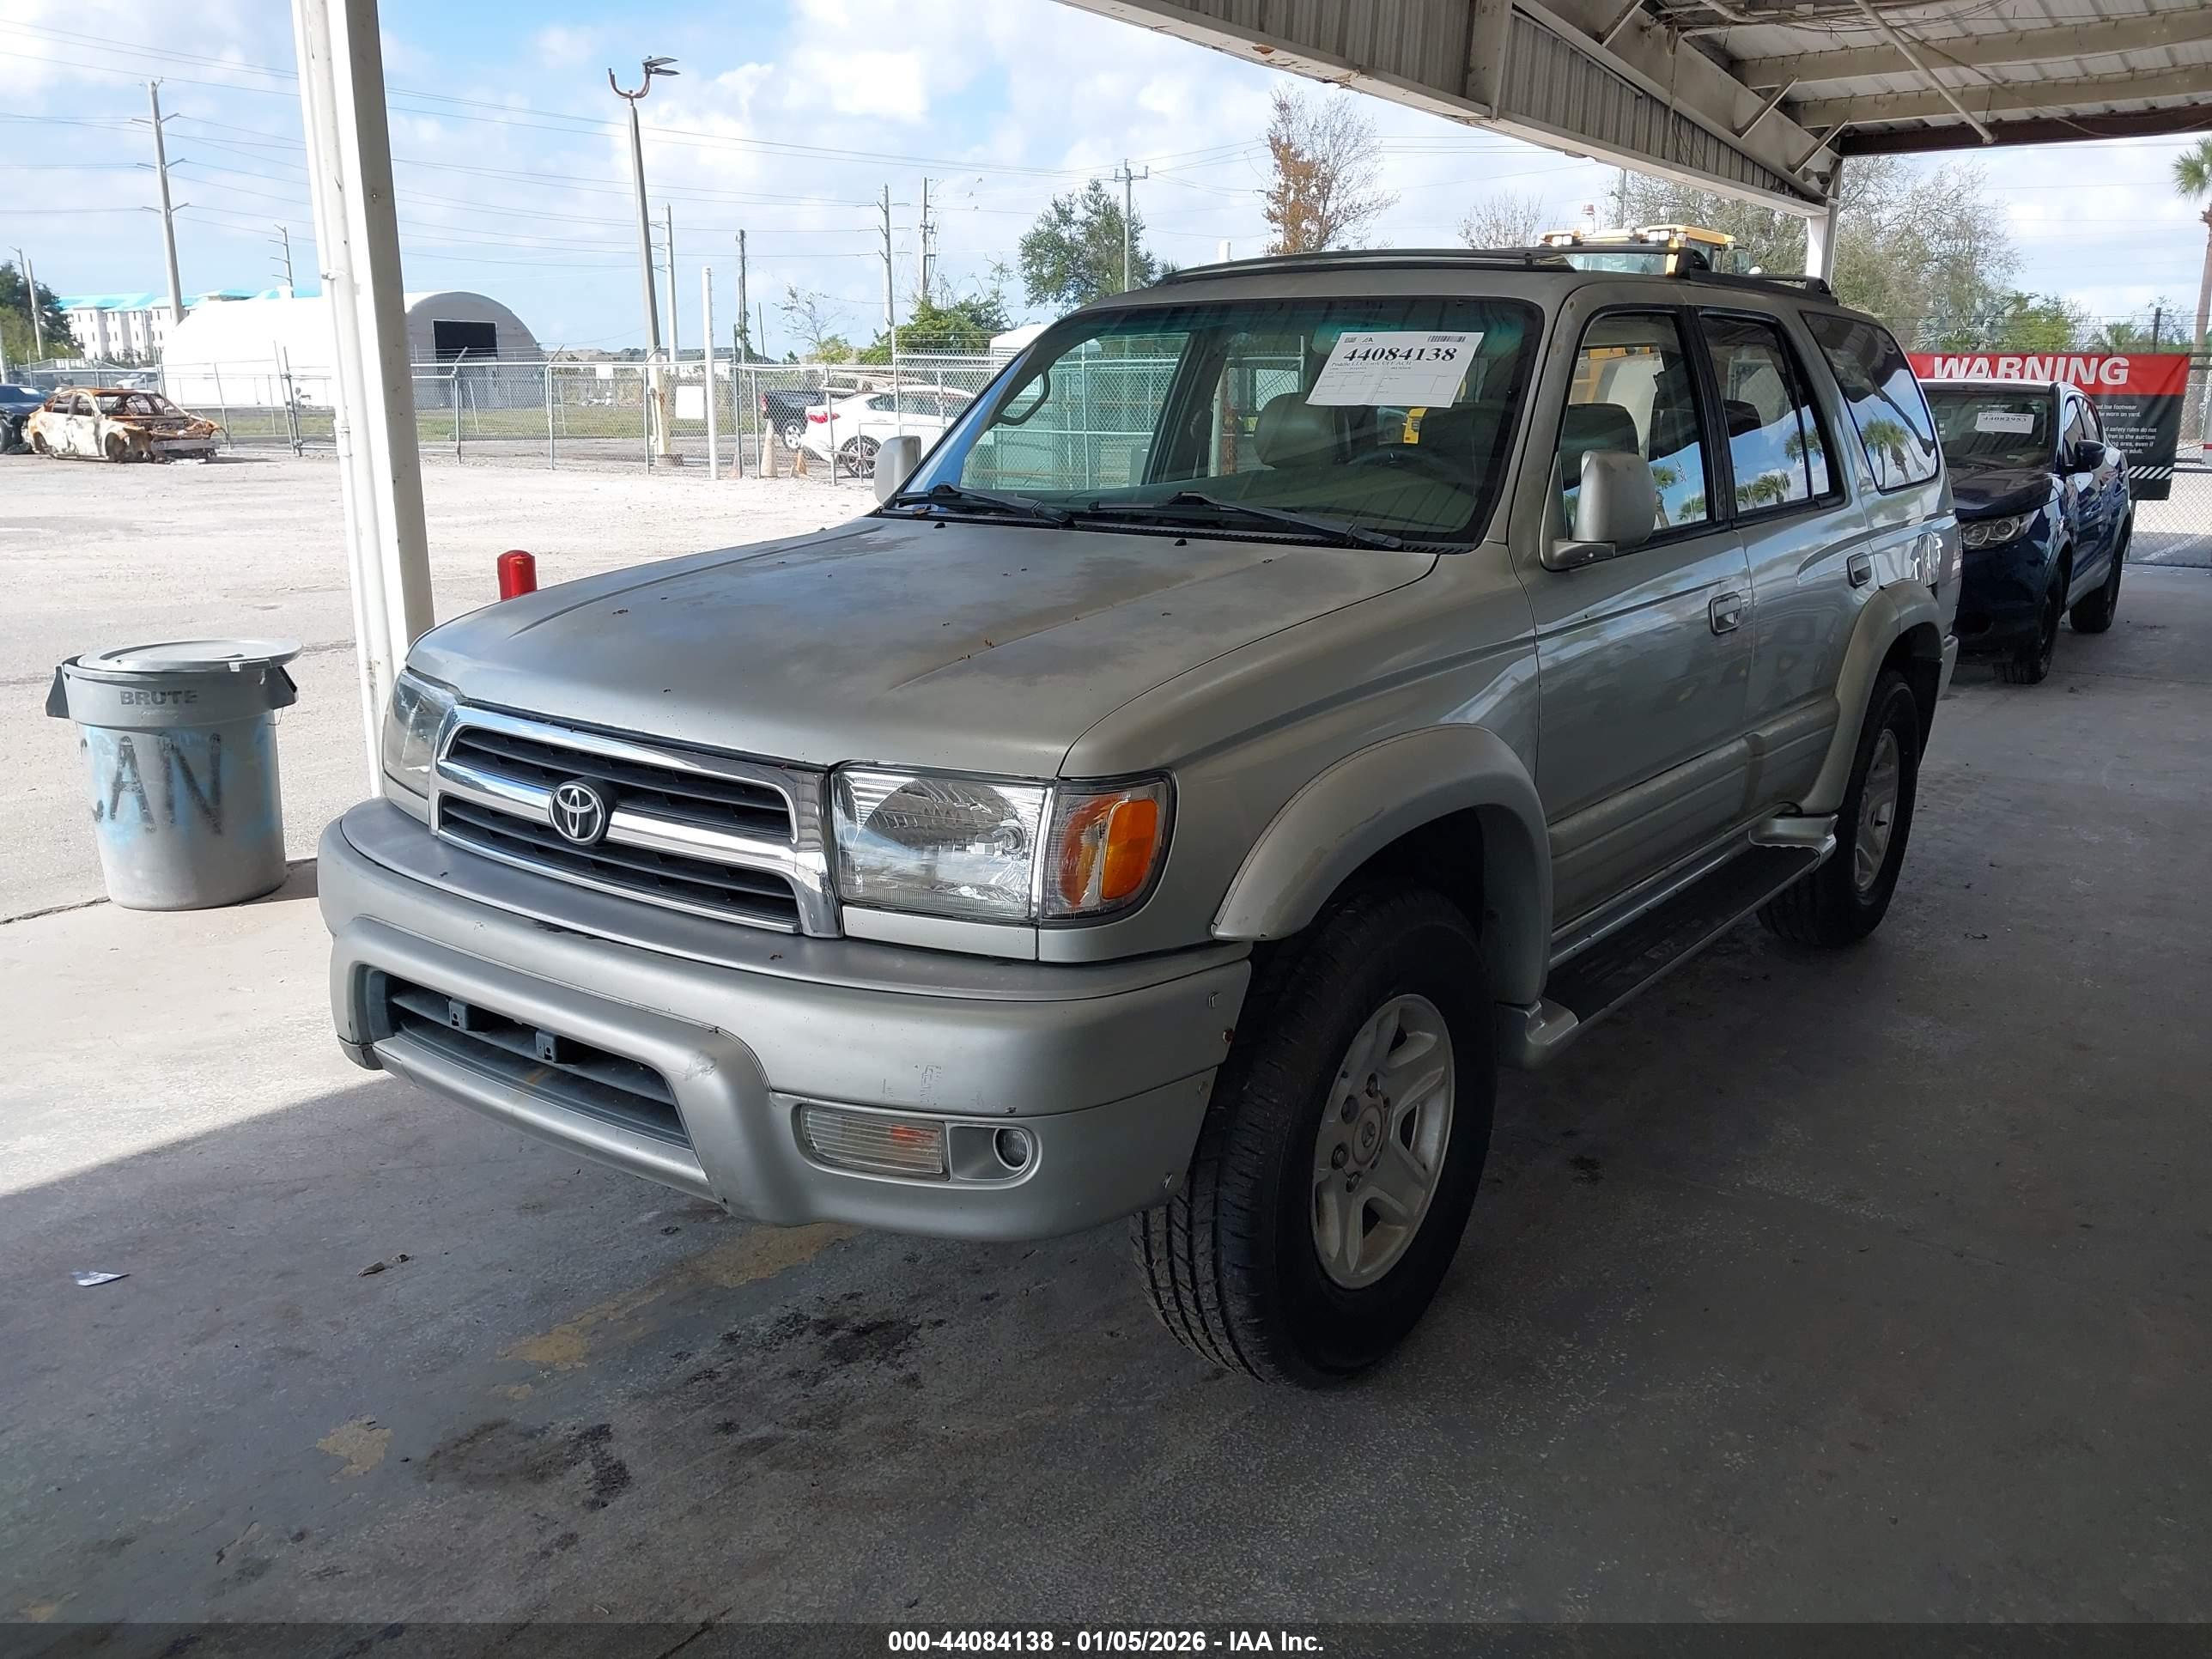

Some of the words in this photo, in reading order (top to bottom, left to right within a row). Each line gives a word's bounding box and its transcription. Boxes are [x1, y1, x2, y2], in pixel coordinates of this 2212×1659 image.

[1343, 347, 1457, 362] 44084138
[1934, 356, 2130, 386] WARNING
[119, 690, 198, 705] BRUTE
